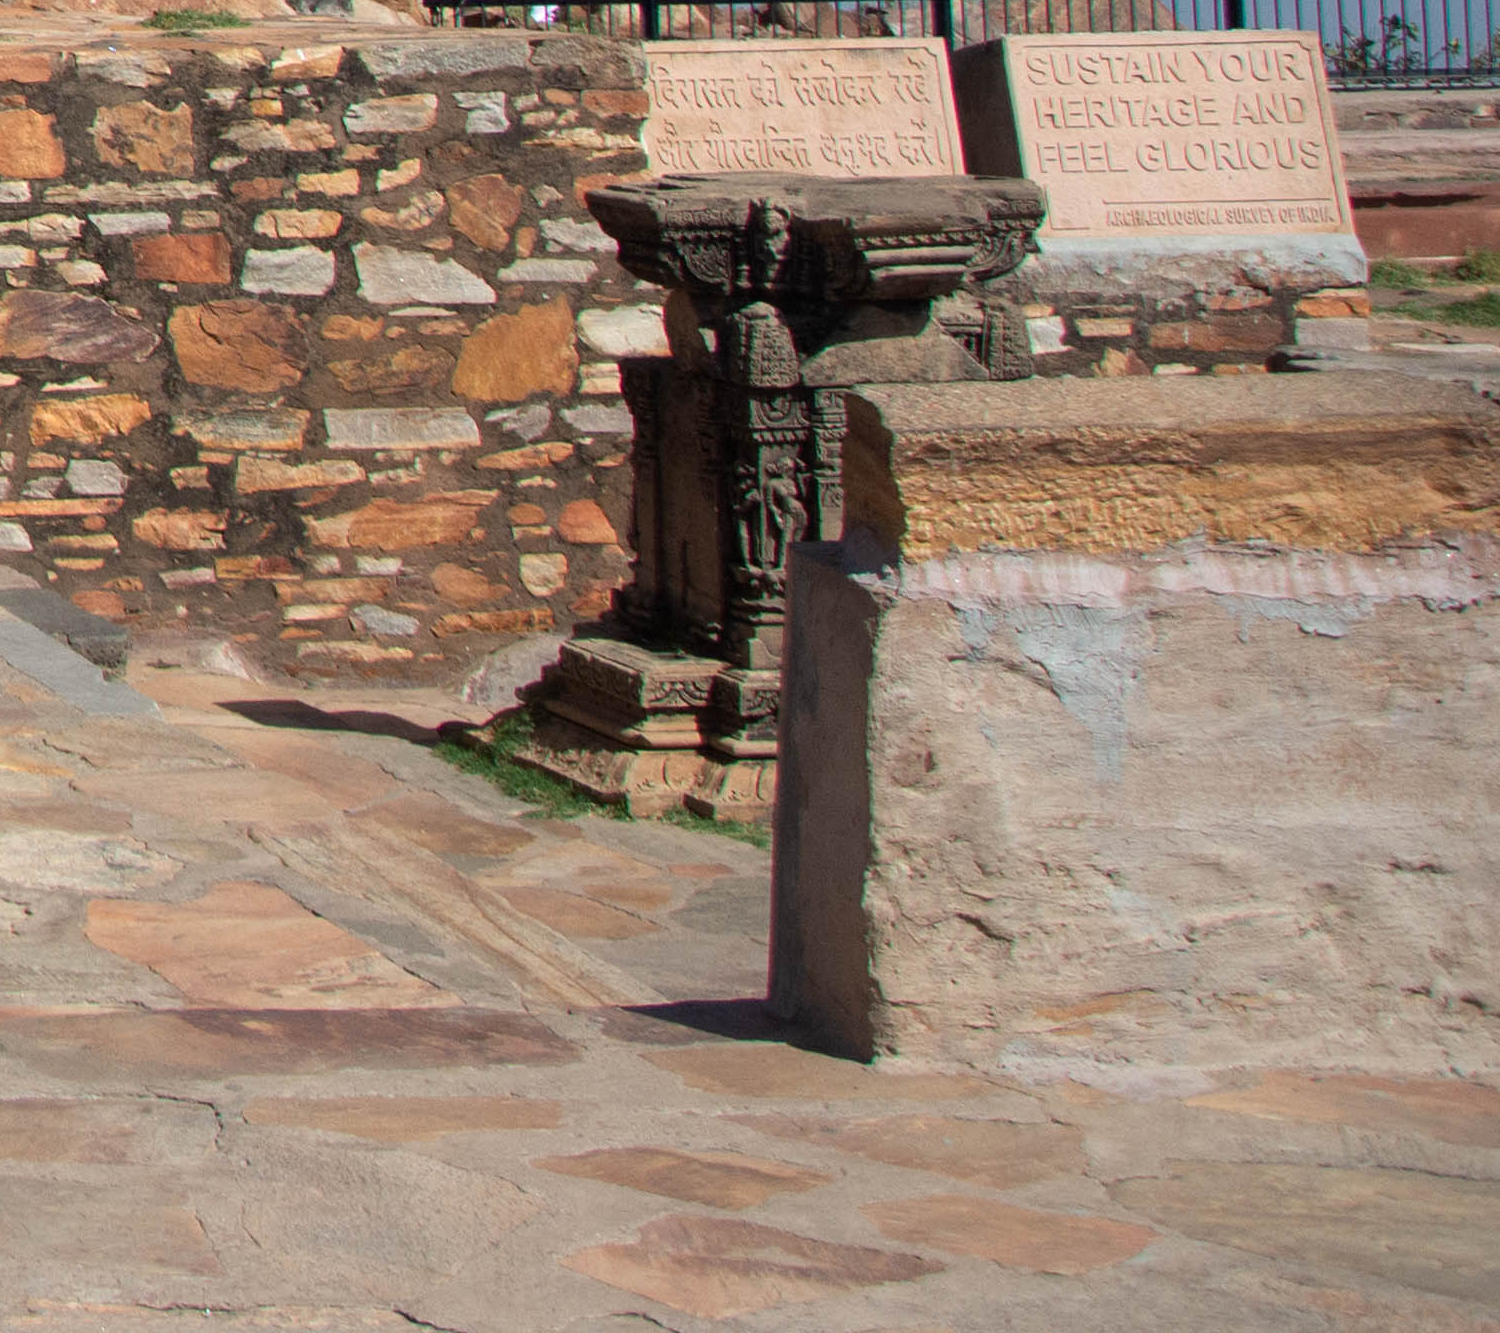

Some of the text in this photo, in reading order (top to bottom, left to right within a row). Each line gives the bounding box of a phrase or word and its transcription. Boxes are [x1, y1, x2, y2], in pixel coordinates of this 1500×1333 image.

[648, 56, 931, 108] विरासत को संजोकर रखें
[1026, 51, 1306, 85] SUSTAIN YOUR
[1033, 93, 1308, 129] HERITAGE AND
[656, 119, 700, 170] और
[819, 132, 891, 177] अनुभव
[1036, 140, 1325, 173] FEEL GLORIOUS
[1105, 206, 1336, 227] ARCHAEOLOGICAL SURVEY OF INDIA
